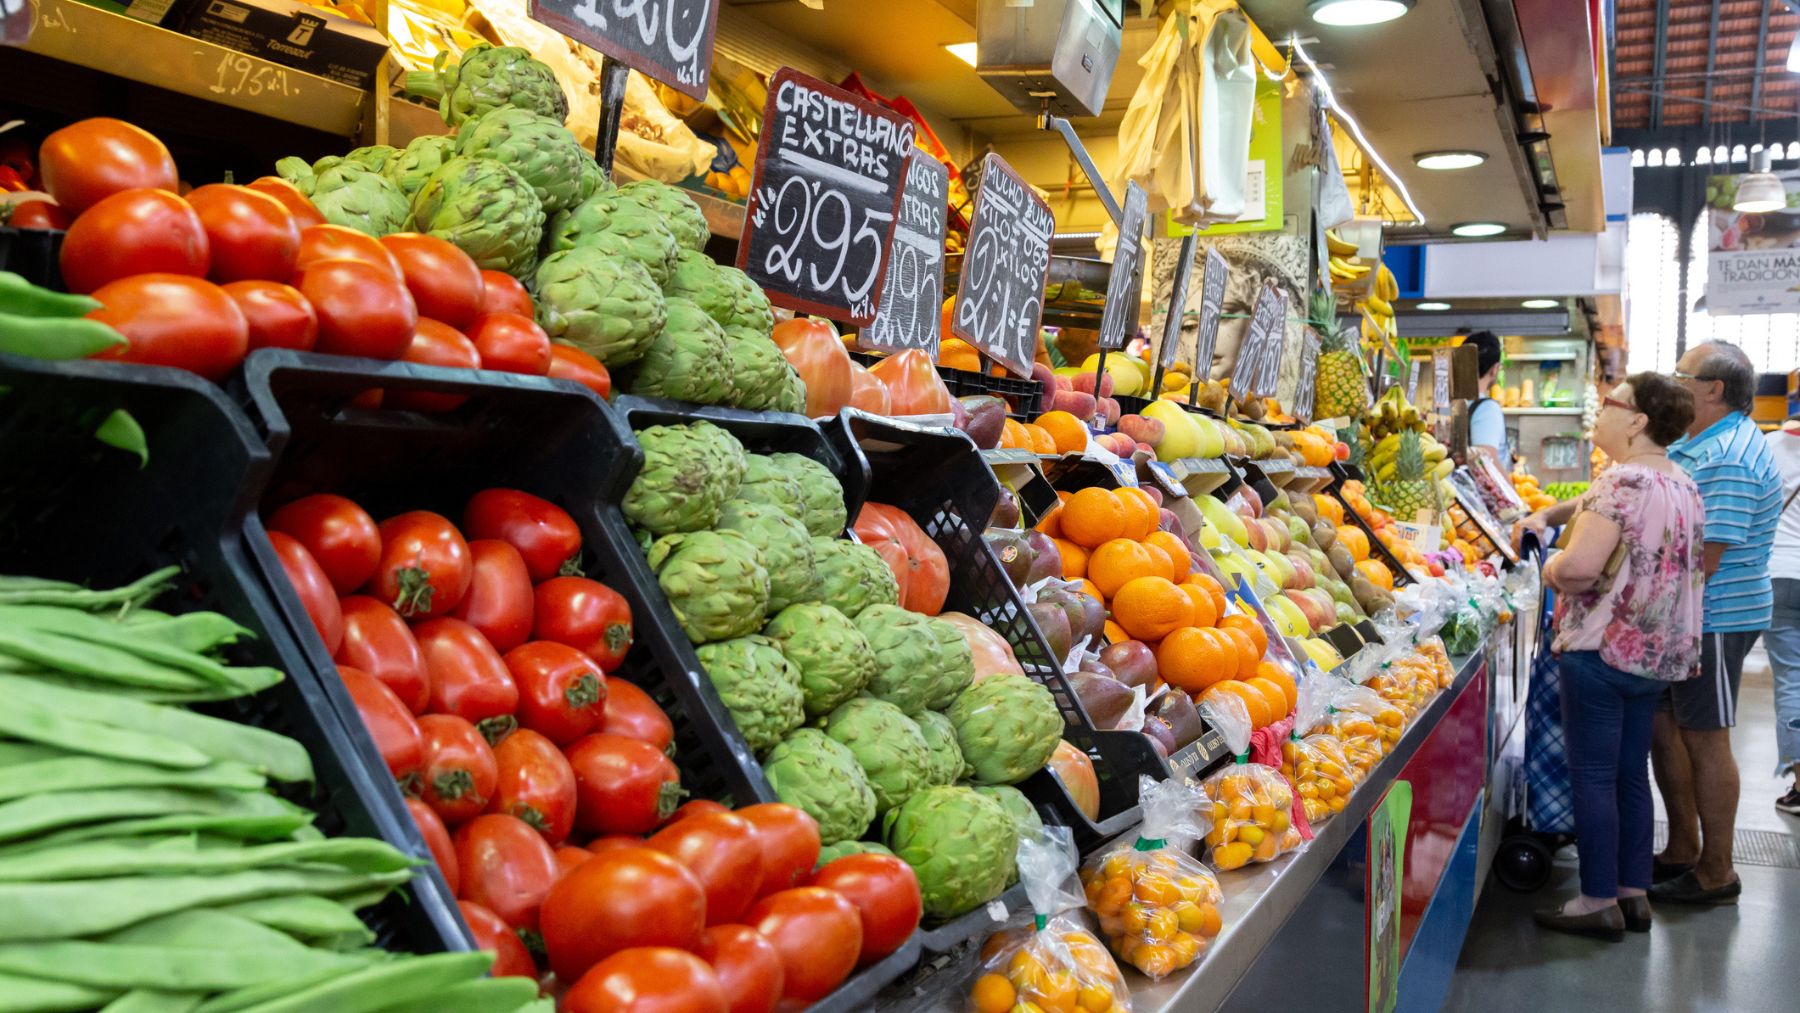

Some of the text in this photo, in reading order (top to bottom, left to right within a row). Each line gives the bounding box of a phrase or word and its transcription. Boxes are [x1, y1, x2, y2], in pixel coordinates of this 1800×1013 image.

[781, 115, 889, 178] EXTRAS
[986, 158, 1024, 208] MUCHO
[1718, 260, 1731, 272] TE
[1737, 258, 1769, 271] DAN
